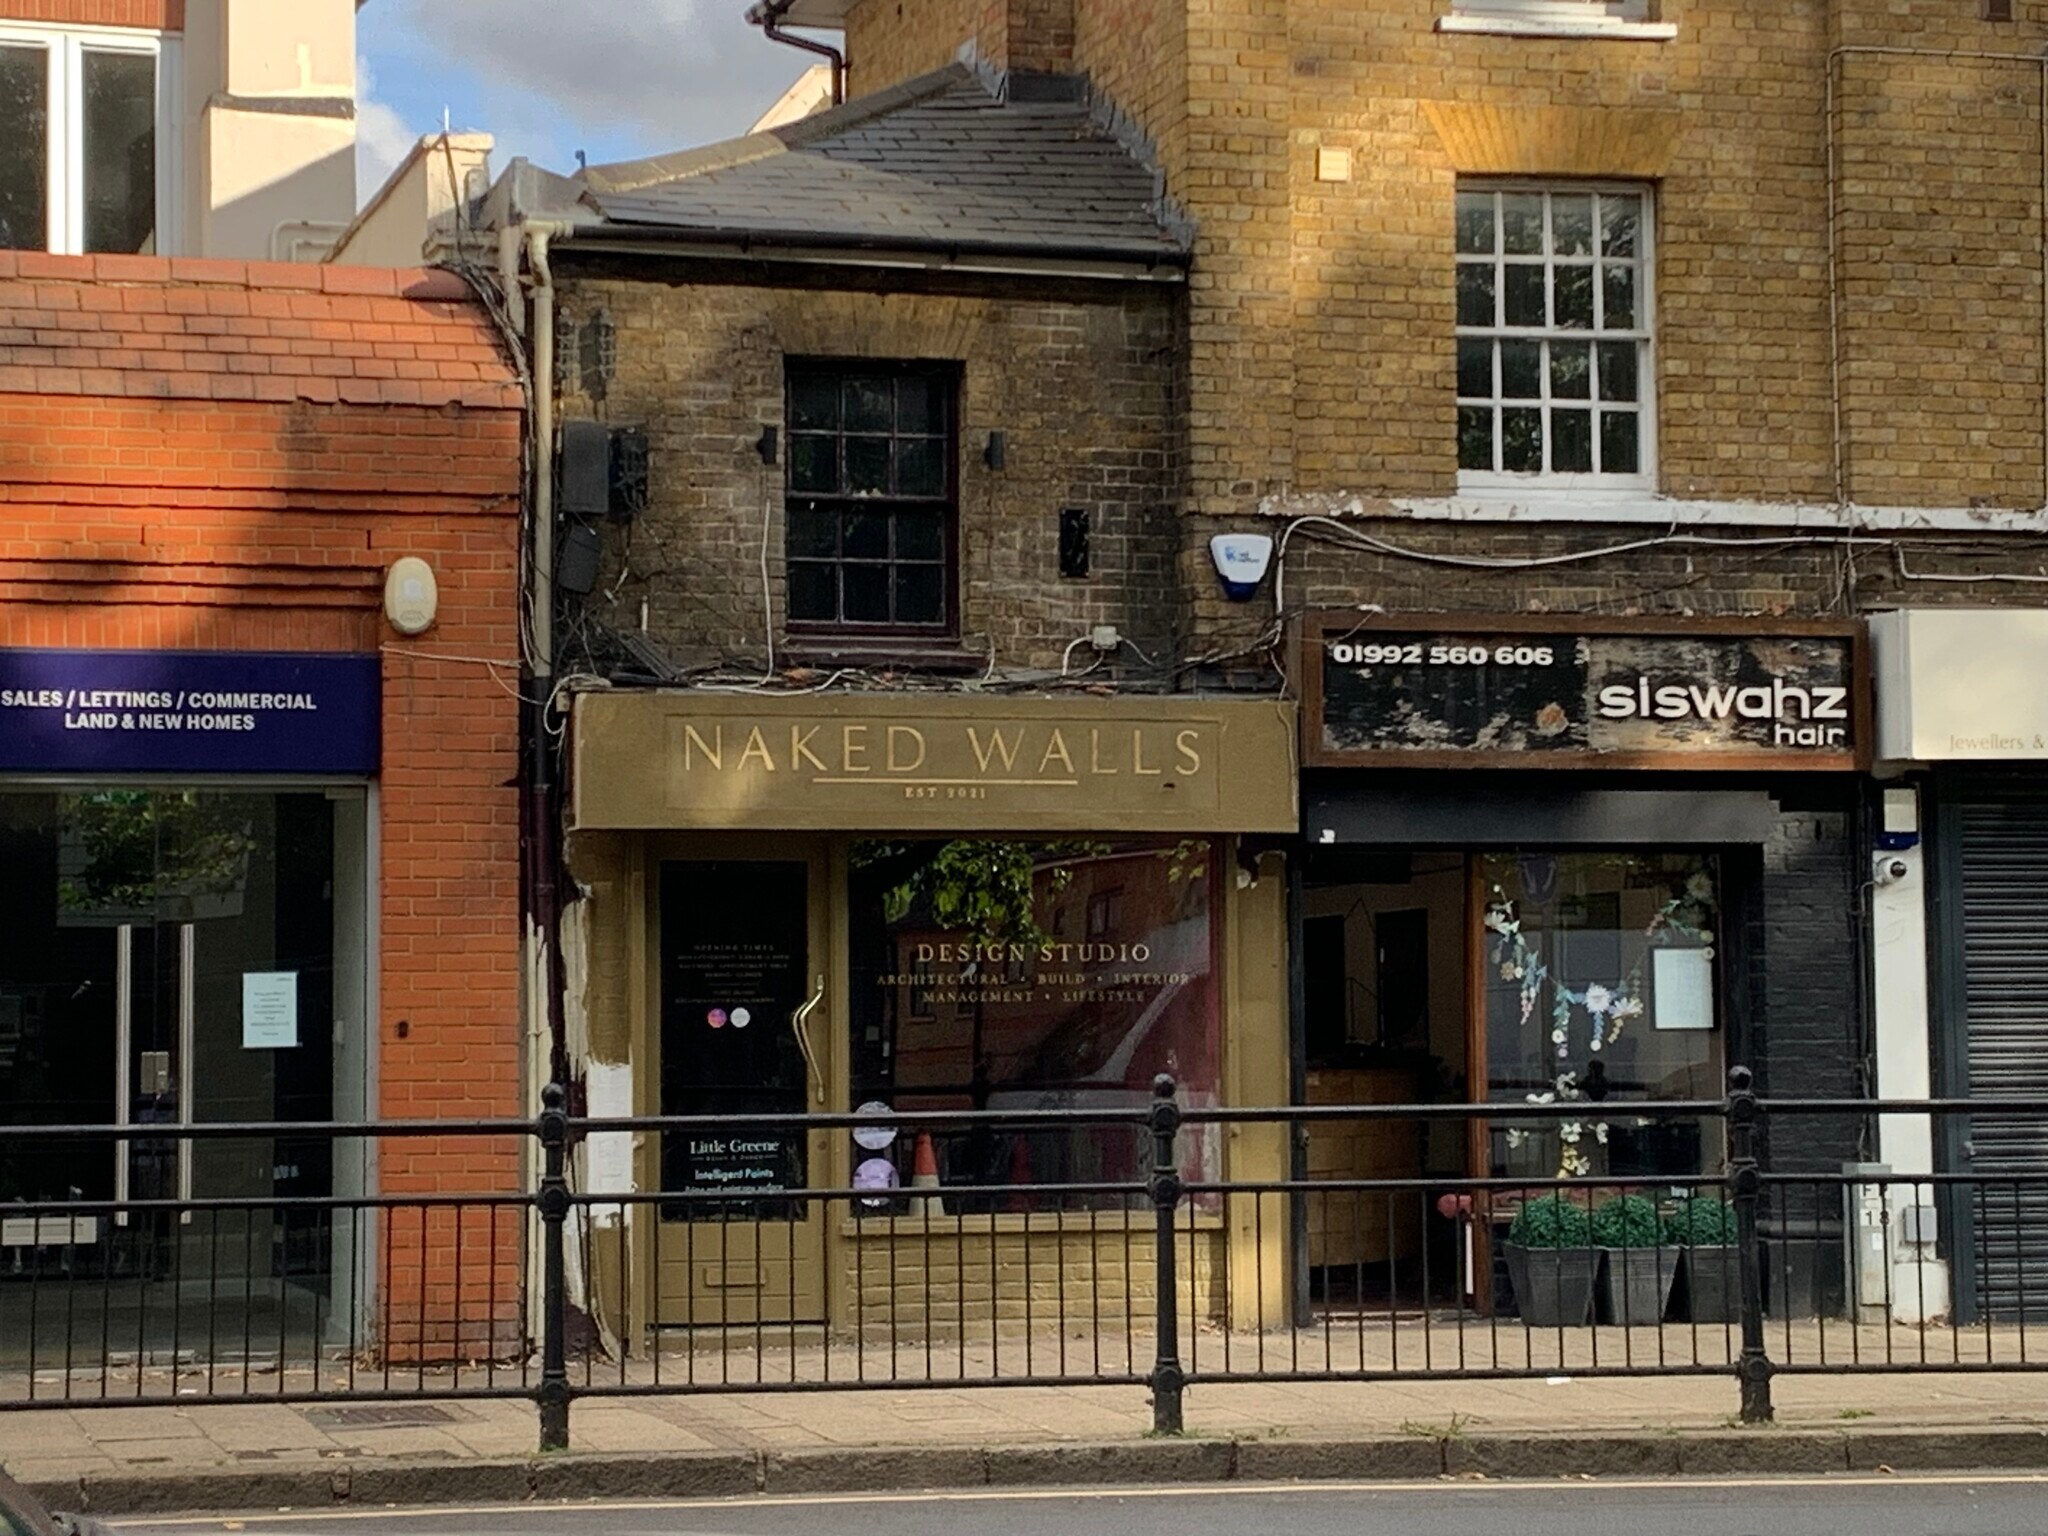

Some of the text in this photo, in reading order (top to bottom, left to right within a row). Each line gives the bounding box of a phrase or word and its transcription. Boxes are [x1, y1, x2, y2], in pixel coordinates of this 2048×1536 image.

[1333, 645, 1554, 667] 01992 560 606
[1, 690, 64, 708] SALES
[79, 691, 173, 709] LETTINGS
[188, 692, 317, 710] COMMERCIAL
[1599, 676, 1848, 720] siswahz
[65, 712, 255, 731] LAND & NEW HOMES
[1774, 723, 1846, 746] hair
[1949, 733, 2047, 752] Jewellers &
[684, 725, 1203, 777] NAKED WALLS
[904, 787, 937, 799] EST
[917, 943, 1150, 963] DESIGN STUDIO
[877, 973, 1190, 986] ARCHITECTURAL BUILD INTERIOR
[922, 991, 1145, 1003] MANAGEMENT LIFESTYLE
[689, 1138, 781, 1155] Little Greene
